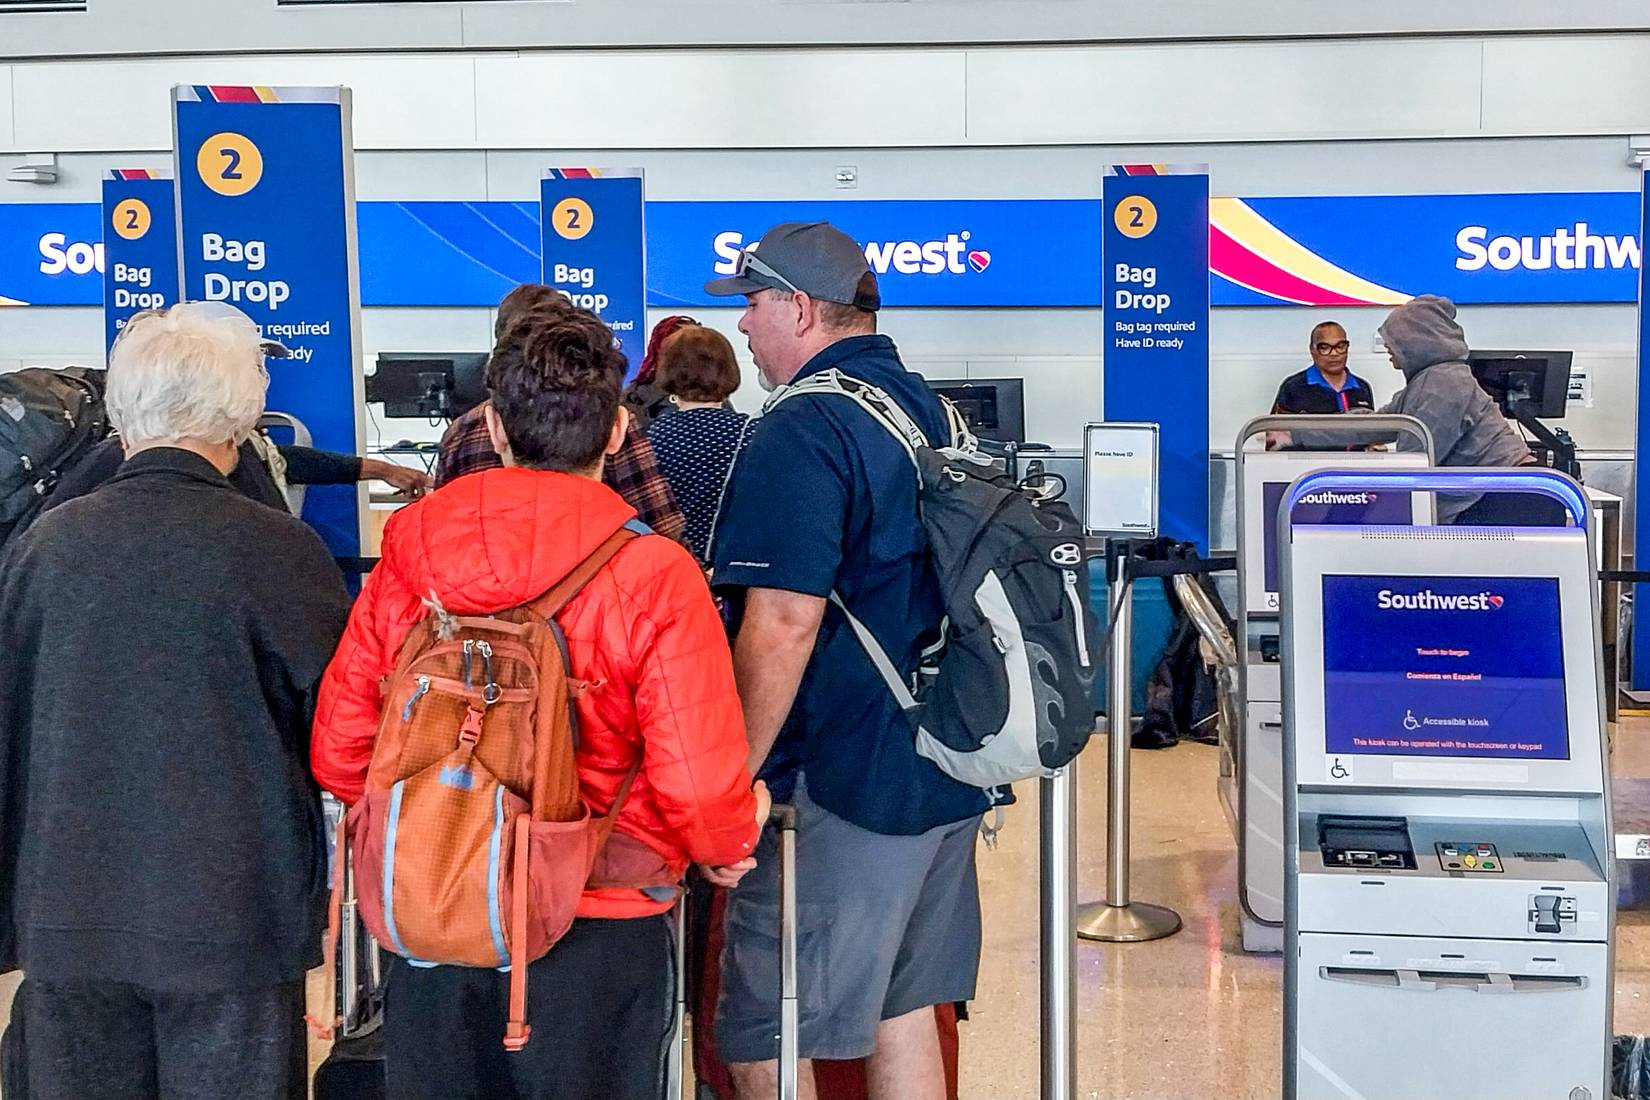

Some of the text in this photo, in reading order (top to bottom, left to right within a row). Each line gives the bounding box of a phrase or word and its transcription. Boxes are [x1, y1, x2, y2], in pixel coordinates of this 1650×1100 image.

[219, 149, 242, 180] 2
[126, 209, 139, 229] 2
[566, 209, 580, 229] 2
[1129, 206, 1144, 227] 2
[202, 233, 265, 270] Bag
[114, 263, 151, 287] Bag
[554, 264, 594, 288] Bag
[1115, 263, 1156, 288] Bag
[115, 289, 164, 309] Drop
[204, 273, 290, 310] Drop
[1115, 290, 1171, 314] Drop
[267, 321, 330, 339] required
[1115, 320, 1195, 334] Bag tag required
[1115, 337, 1184, 350] Have ID ready
[1378, 590, 1490, 610] Southwest
[1423, 717, 1489, 727] Accessible kiosk
[1353, 738, 1367, 746] This
[1368, 738, 1386, 746] kiosk
[1410, 740, 1440, 748] operated
[1467, 741, 1509, 749] touchscreen
[1518, 743, 1543, 751] keypad
